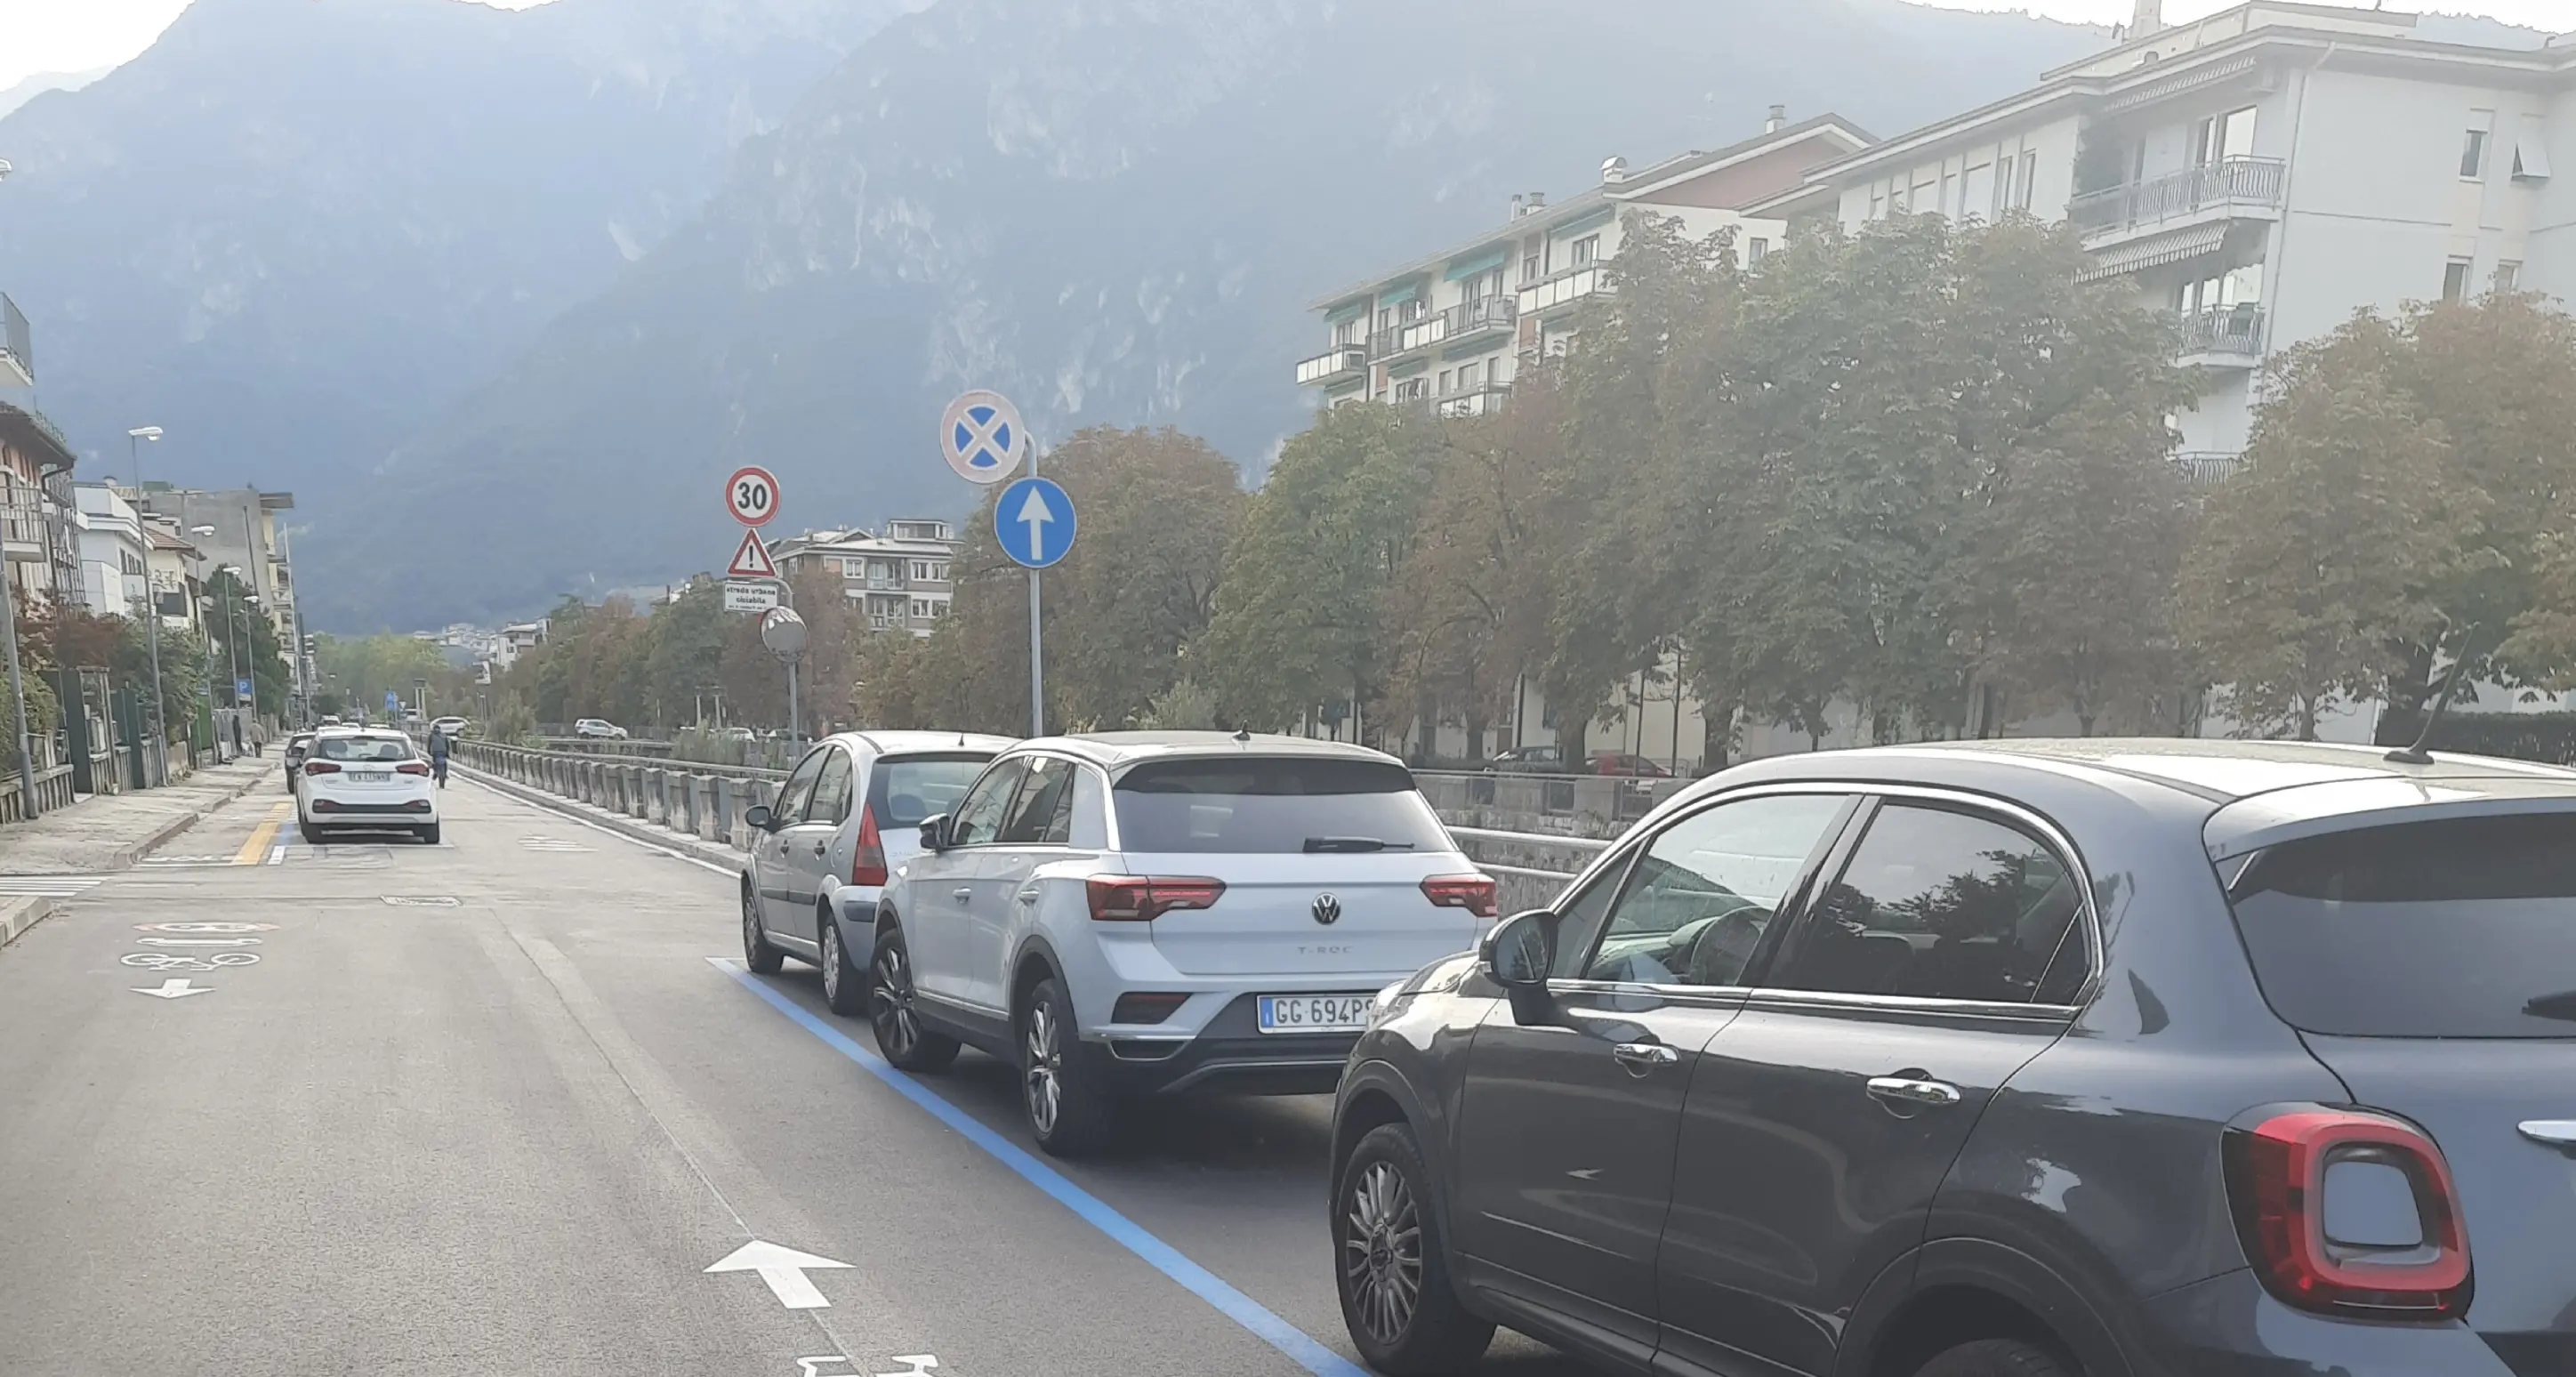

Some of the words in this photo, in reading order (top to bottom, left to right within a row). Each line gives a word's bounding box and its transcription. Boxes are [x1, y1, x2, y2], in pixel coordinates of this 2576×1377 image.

[738, 482, 767, 510] 30
[238, 681, 247, 692] P
[1298, 946, 1354, 954] T-ROC
[1276, 1000, 1302, 1024] GG
